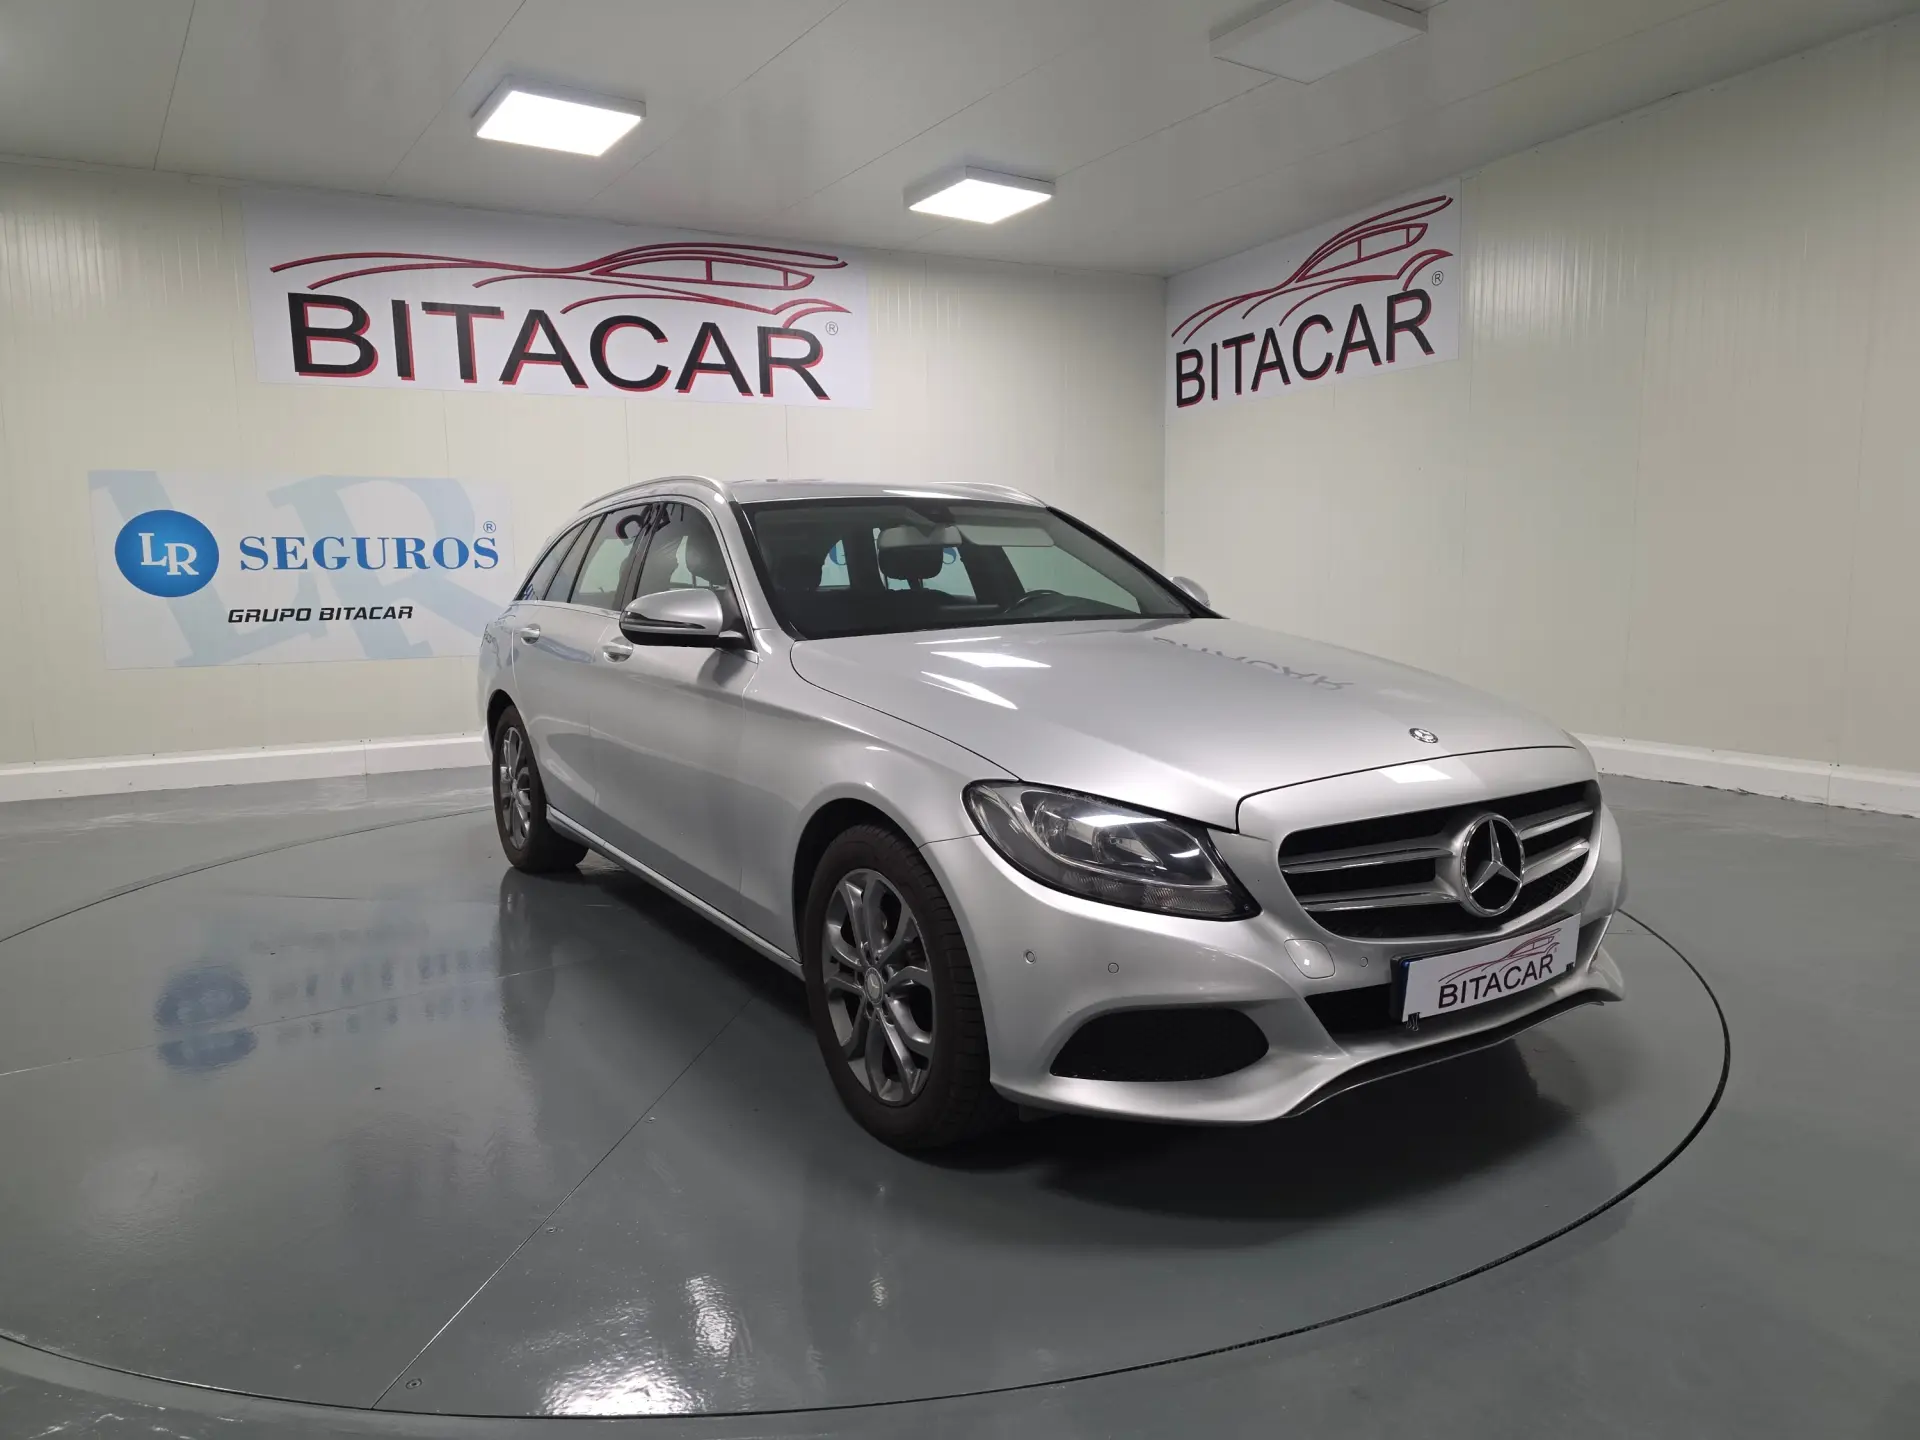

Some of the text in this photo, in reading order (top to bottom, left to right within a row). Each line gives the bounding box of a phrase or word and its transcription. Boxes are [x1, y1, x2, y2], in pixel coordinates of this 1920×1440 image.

[287, 292, 830, 401] BITACAR
[1176, 289, 1435, 408] BITACAR
[138, 532, 199, 576] LR
[239, 536, 499, 571] SEGUROS
[227, 606, 413, 623] GRUPO BITACAR
[1438, 955, 1553, 1009] BITACAR
